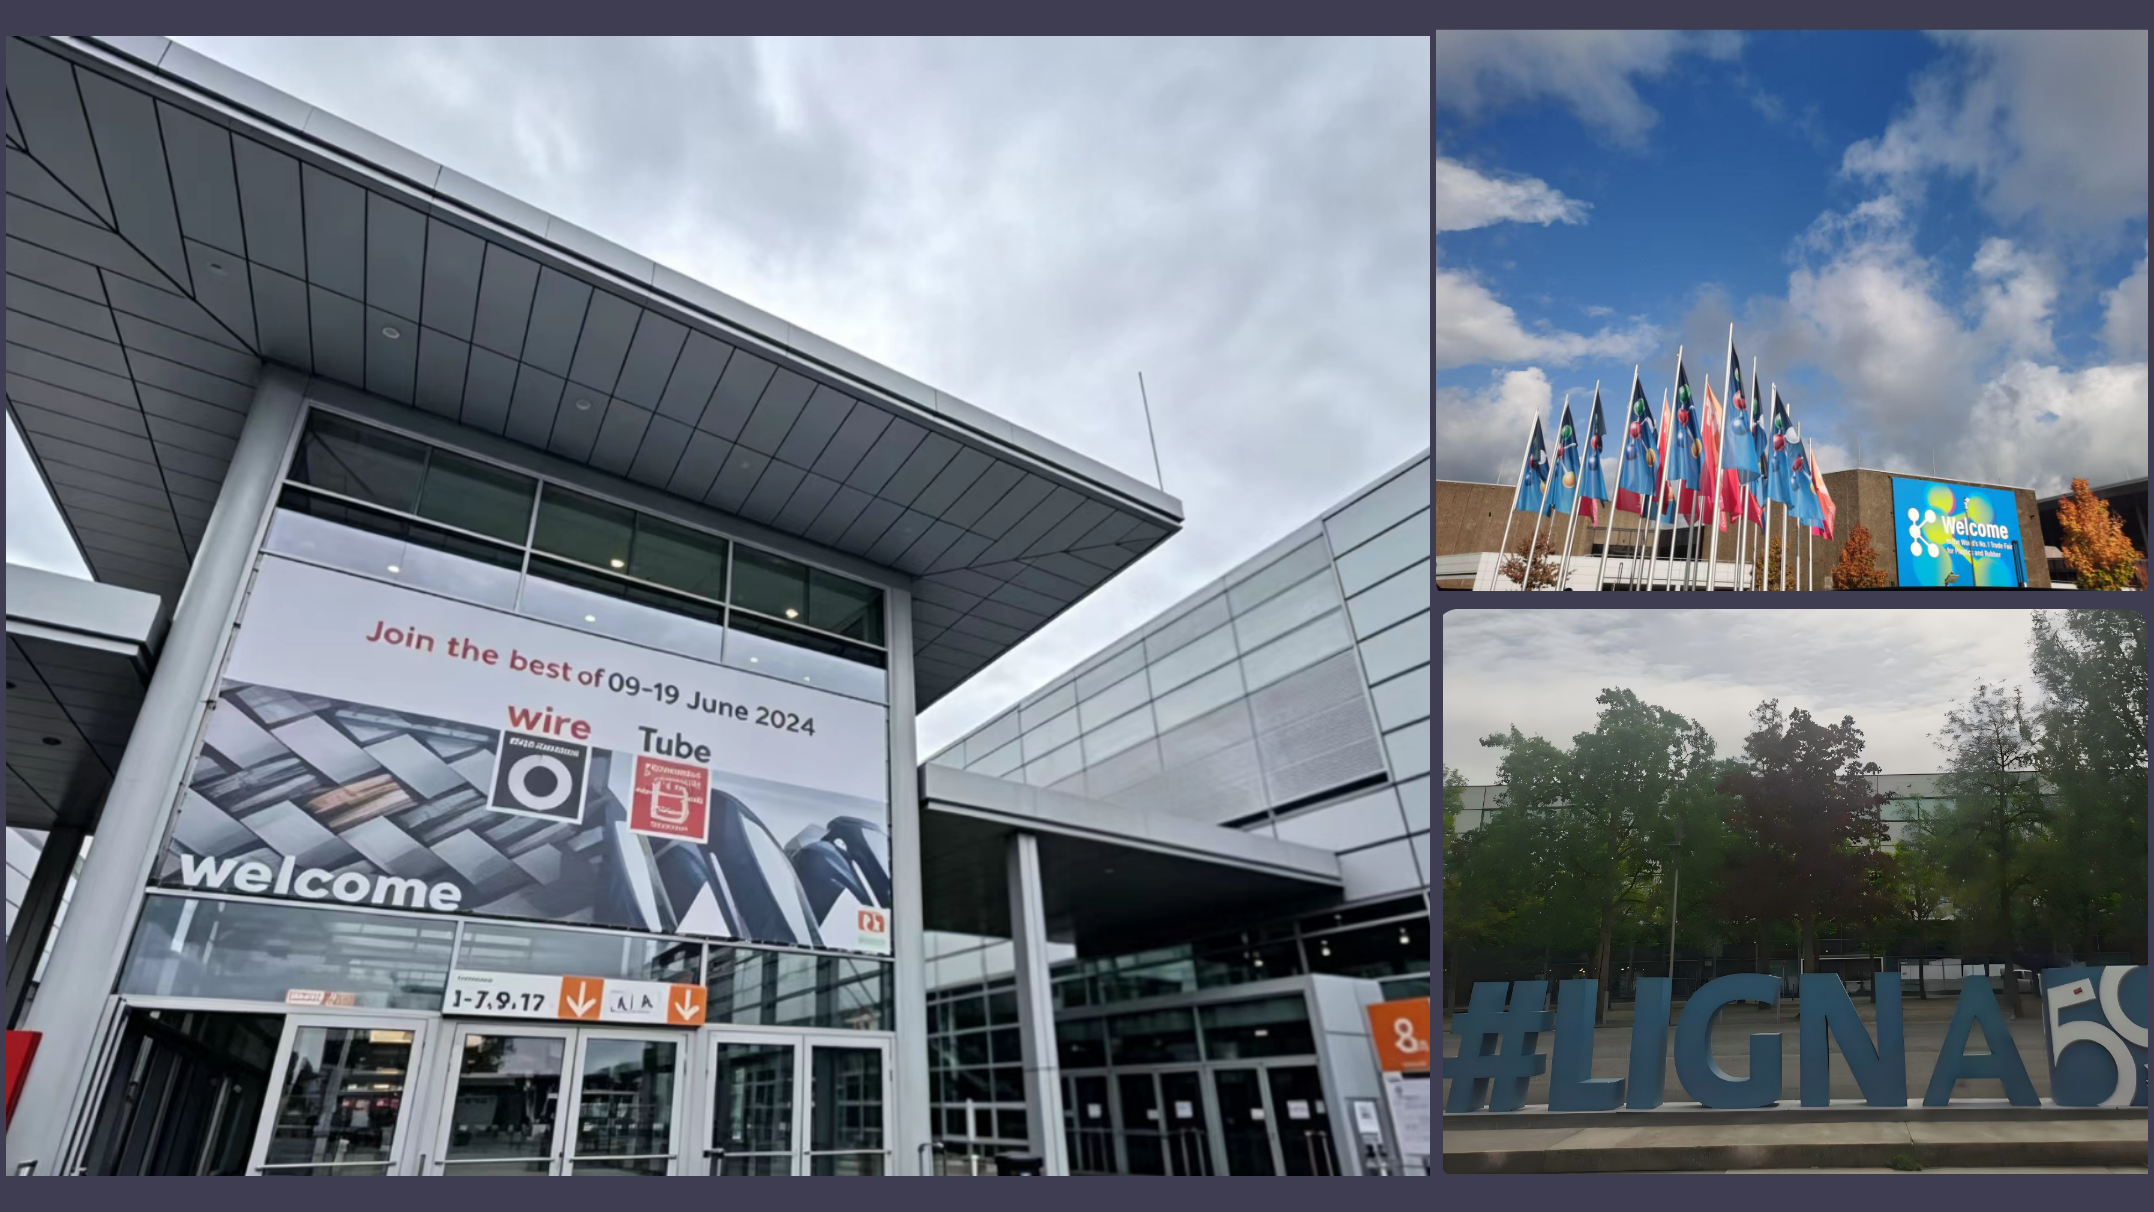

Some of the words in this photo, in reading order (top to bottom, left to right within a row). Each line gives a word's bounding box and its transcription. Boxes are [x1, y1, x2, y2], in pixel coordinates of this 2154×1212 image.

[1941, 515, 2009, 540] Welcome
[1961, 539, 1979, 548] Word's
[1990, 541, 2003, 549] Trade
[1984, 550, 2001, 558] Rubber
[366, 620, 435, 652] Join
[447, 637, 499, 665] the
[509, 649, 573, 682] best
[577, 668, 606, 688] of
[507, 704, 592, 741] wire
[608, 672, 680, 705] 09-19
[686, 691, 749, 721] June
[755, 706, 816, 736] 2024
[638, 725, 711, 763] Tube
[180, 853, 462, 912] welcome
